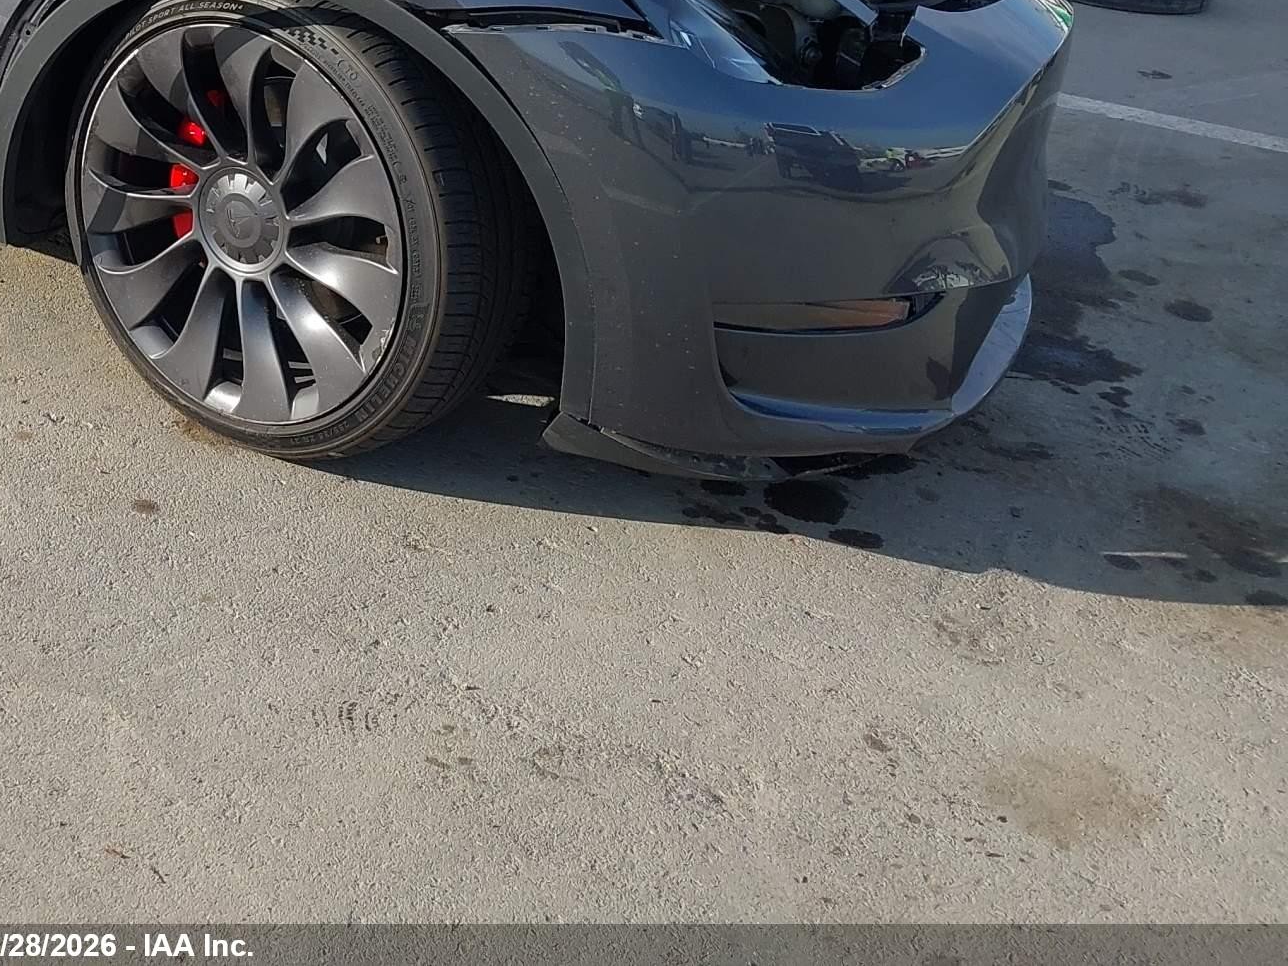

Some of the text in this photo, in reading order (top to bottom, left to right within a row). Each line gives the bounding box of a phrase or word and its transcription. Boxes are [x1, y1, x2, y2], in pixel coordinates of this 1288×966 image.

[147, 6, 176, 24] SPORT
[178, 3, 196, 12] ALL
[198, 1, 238, 11] SEASON
